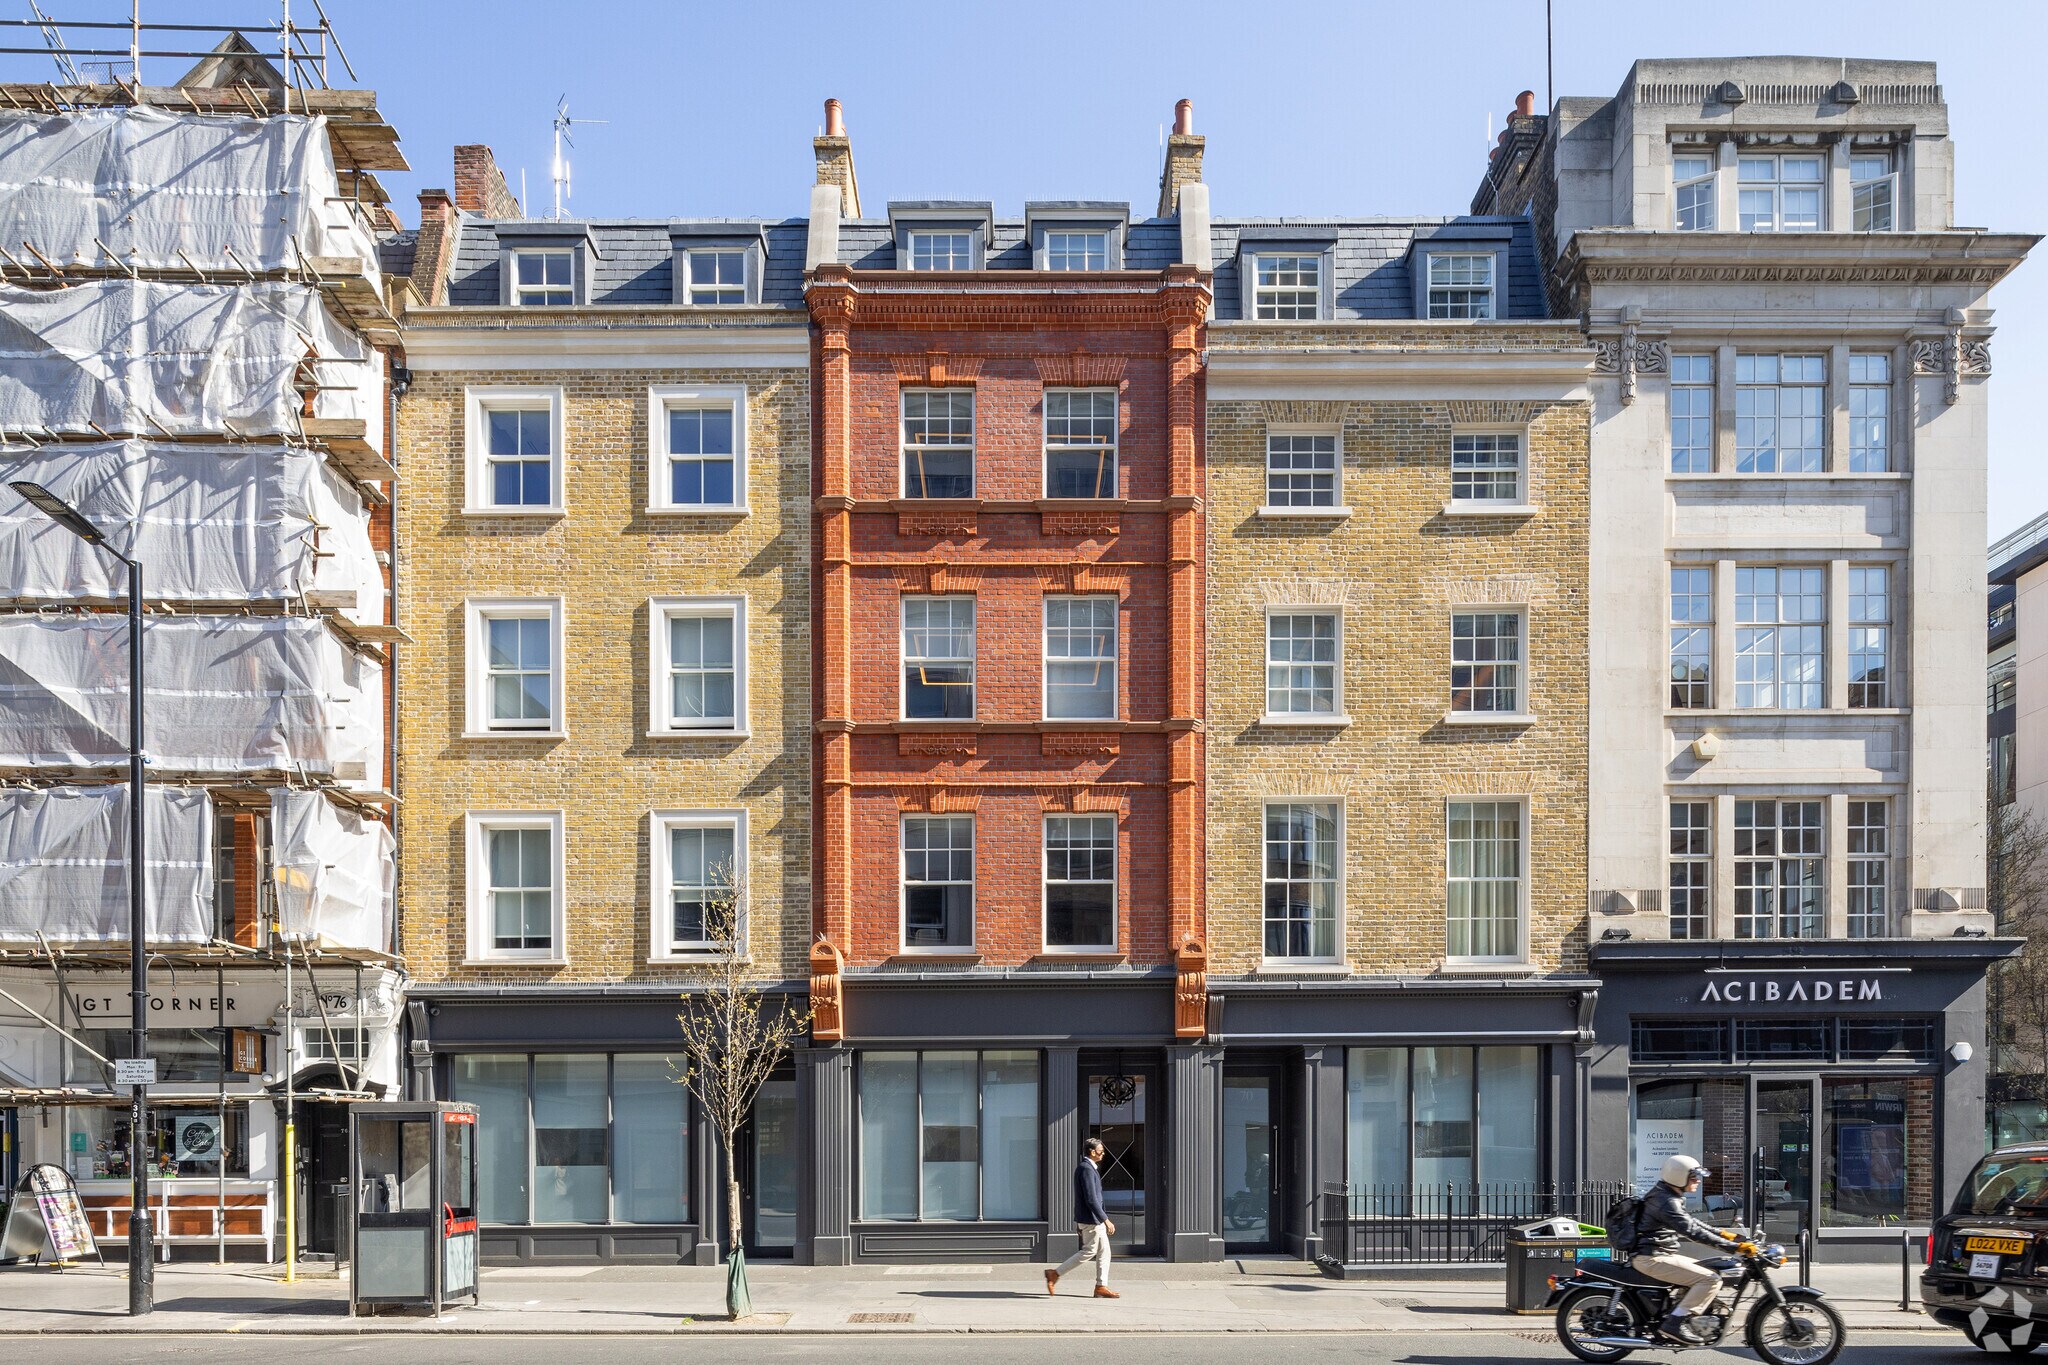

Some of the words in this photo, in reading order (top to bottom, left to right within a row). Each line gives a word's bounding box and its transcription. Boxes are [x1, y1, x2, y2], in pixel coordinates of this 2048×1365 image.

[1700, 979, 1882, 1001] ACIBADEM
[83, 998, 111, 1011] GT
[150, 997, 236, 1011] ORNER
[187, 1128, 210, 1139] Coffee
[184, 1138, 193, 1147] &
[192, 1138, 212, 1147] Cake
[1998, 1239, 2020, 1252] VXE
